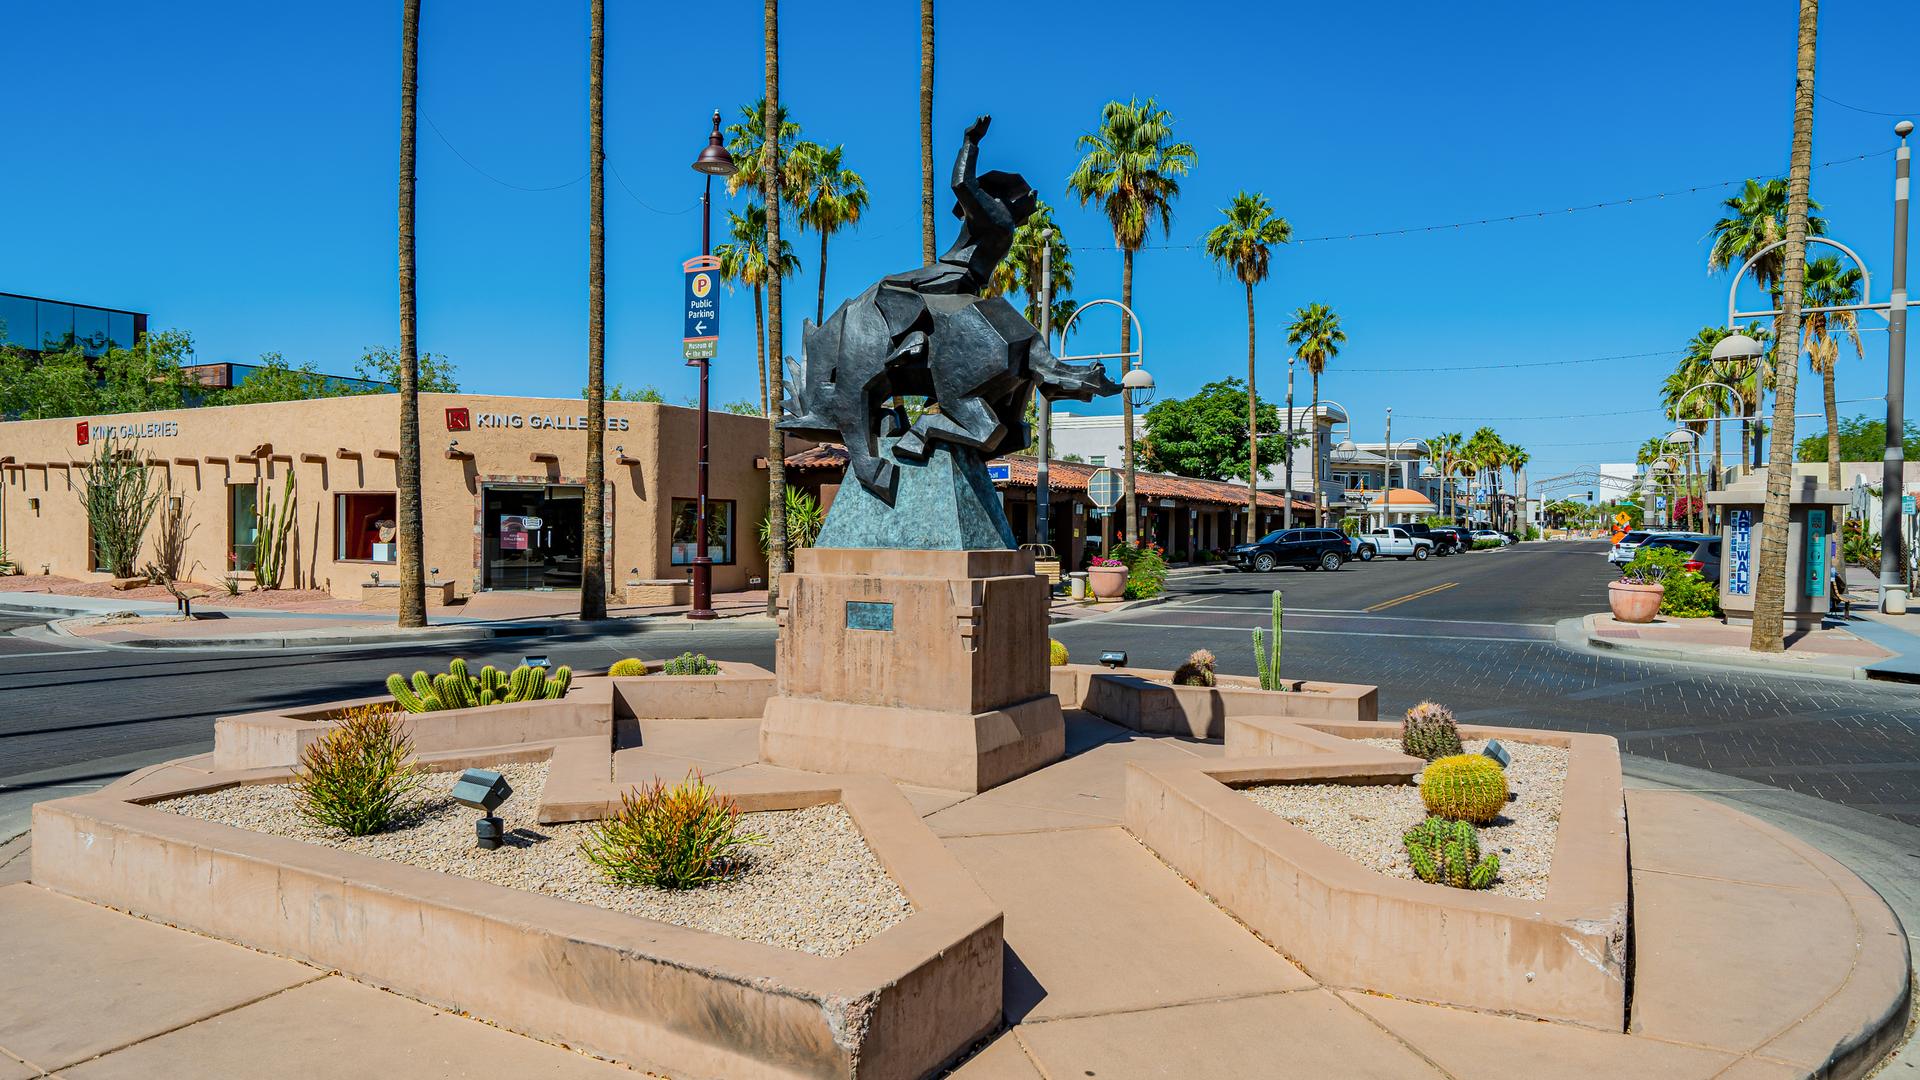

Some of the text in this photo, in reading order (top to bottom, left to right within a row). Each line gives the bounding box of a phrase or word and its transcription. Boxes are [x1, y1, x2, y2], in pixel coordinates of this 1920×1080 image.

[697, 279, 707, 292] P
[691, 300, 713, 309] Public
[688, 310, 715, 320] Parking
[688, 341, 713, 350] Museum of
[476, 413, 630, 431] KING GALLEES
[120, 421, 178, 439] GALLERIES
[1737, 550, 1749, 595] WALK
